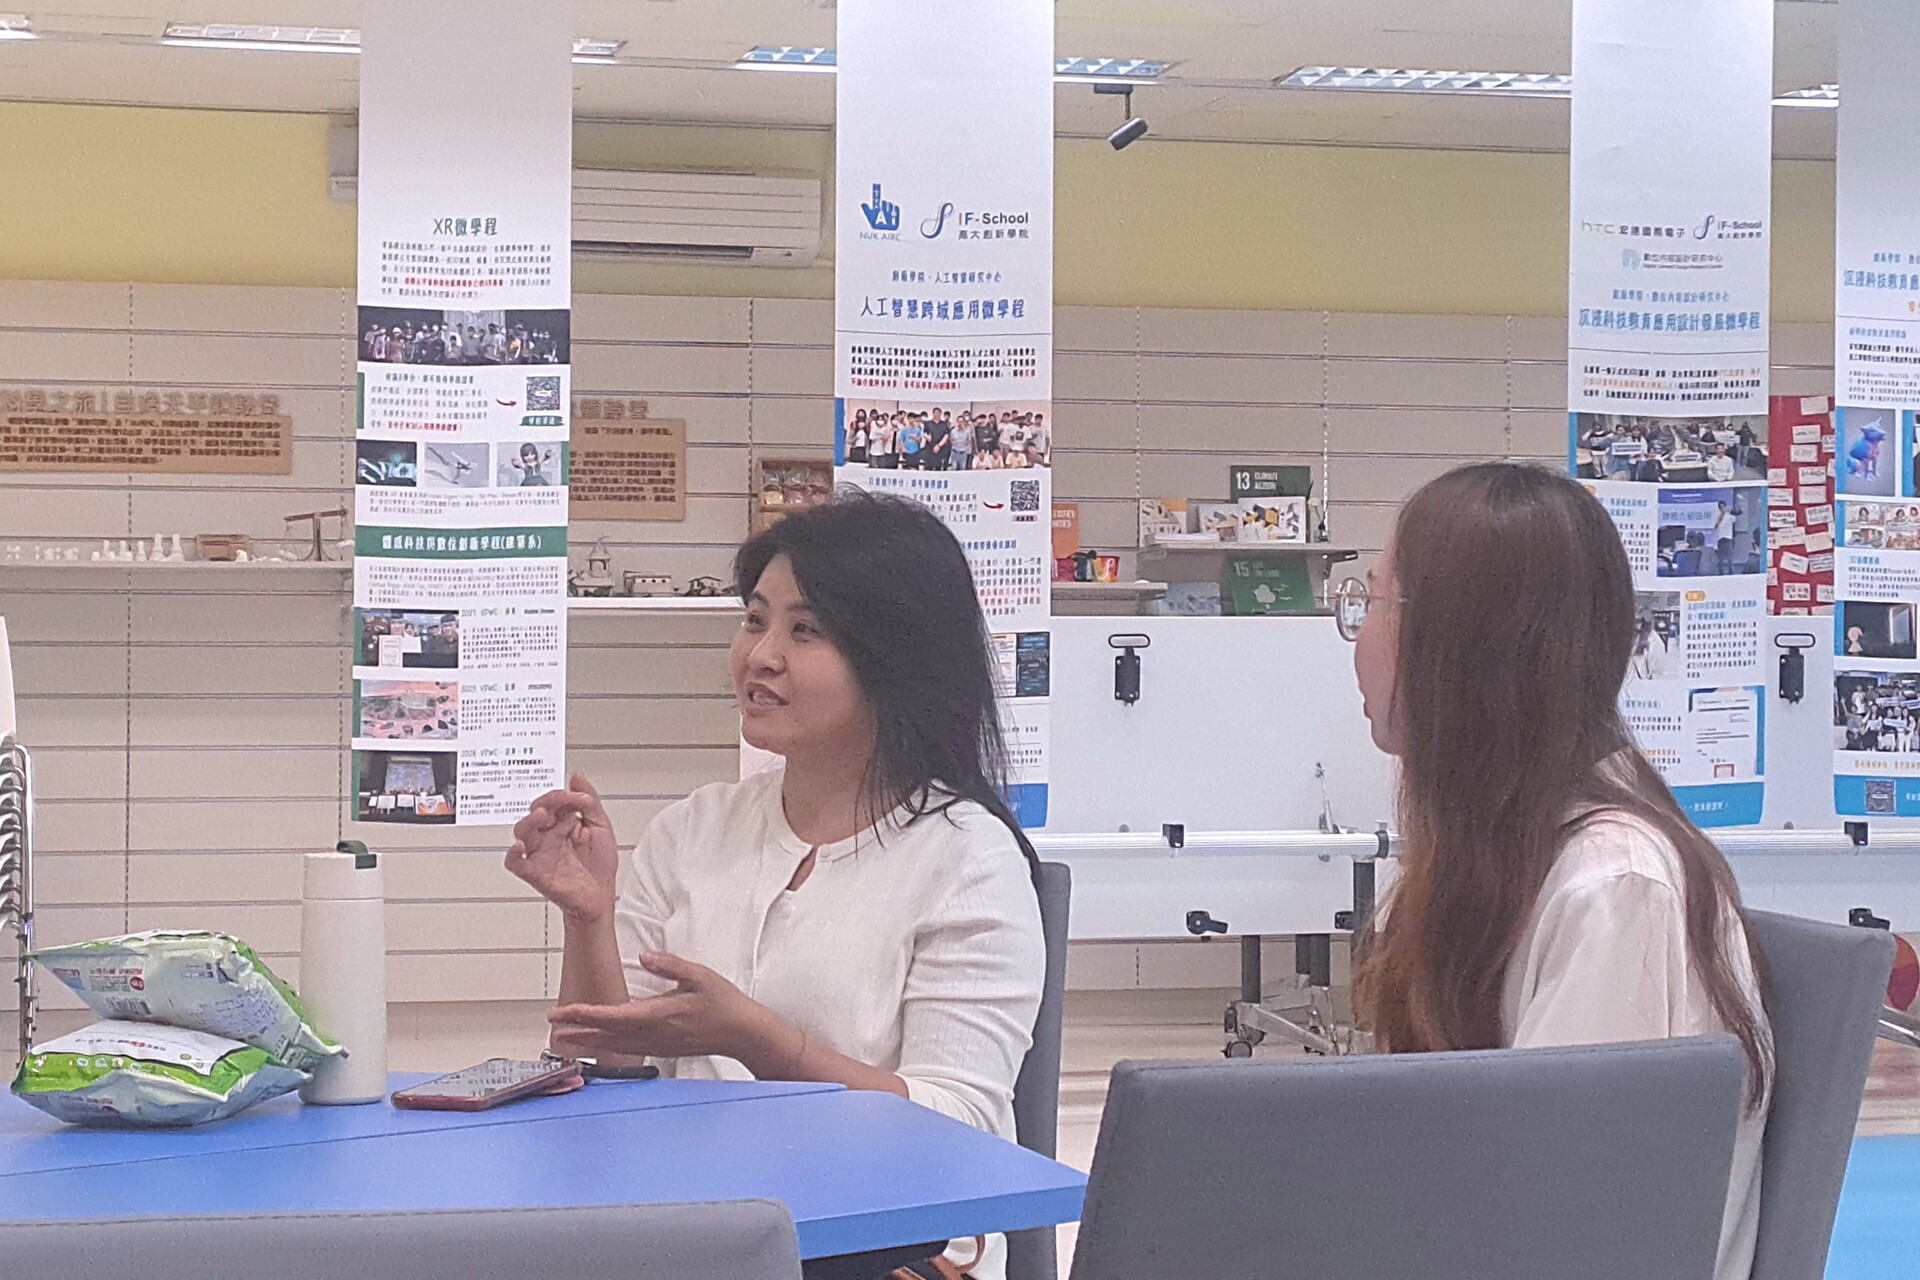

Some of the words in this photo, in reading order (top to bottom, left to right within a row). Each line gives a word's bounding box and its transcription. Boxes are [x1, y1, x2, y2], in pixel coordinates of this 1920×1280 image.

[432, 217, 498, 236] XR微學程
[958, 212, 1029, 225] IF-School
[958, 228, 1029, 240] 高大創新學院
[861, 296, 1025, 320] 人工智慧跨域應用微學程
[1236, 471, 1251, 490] 13
[1233, 561, 1250, 578] 15
